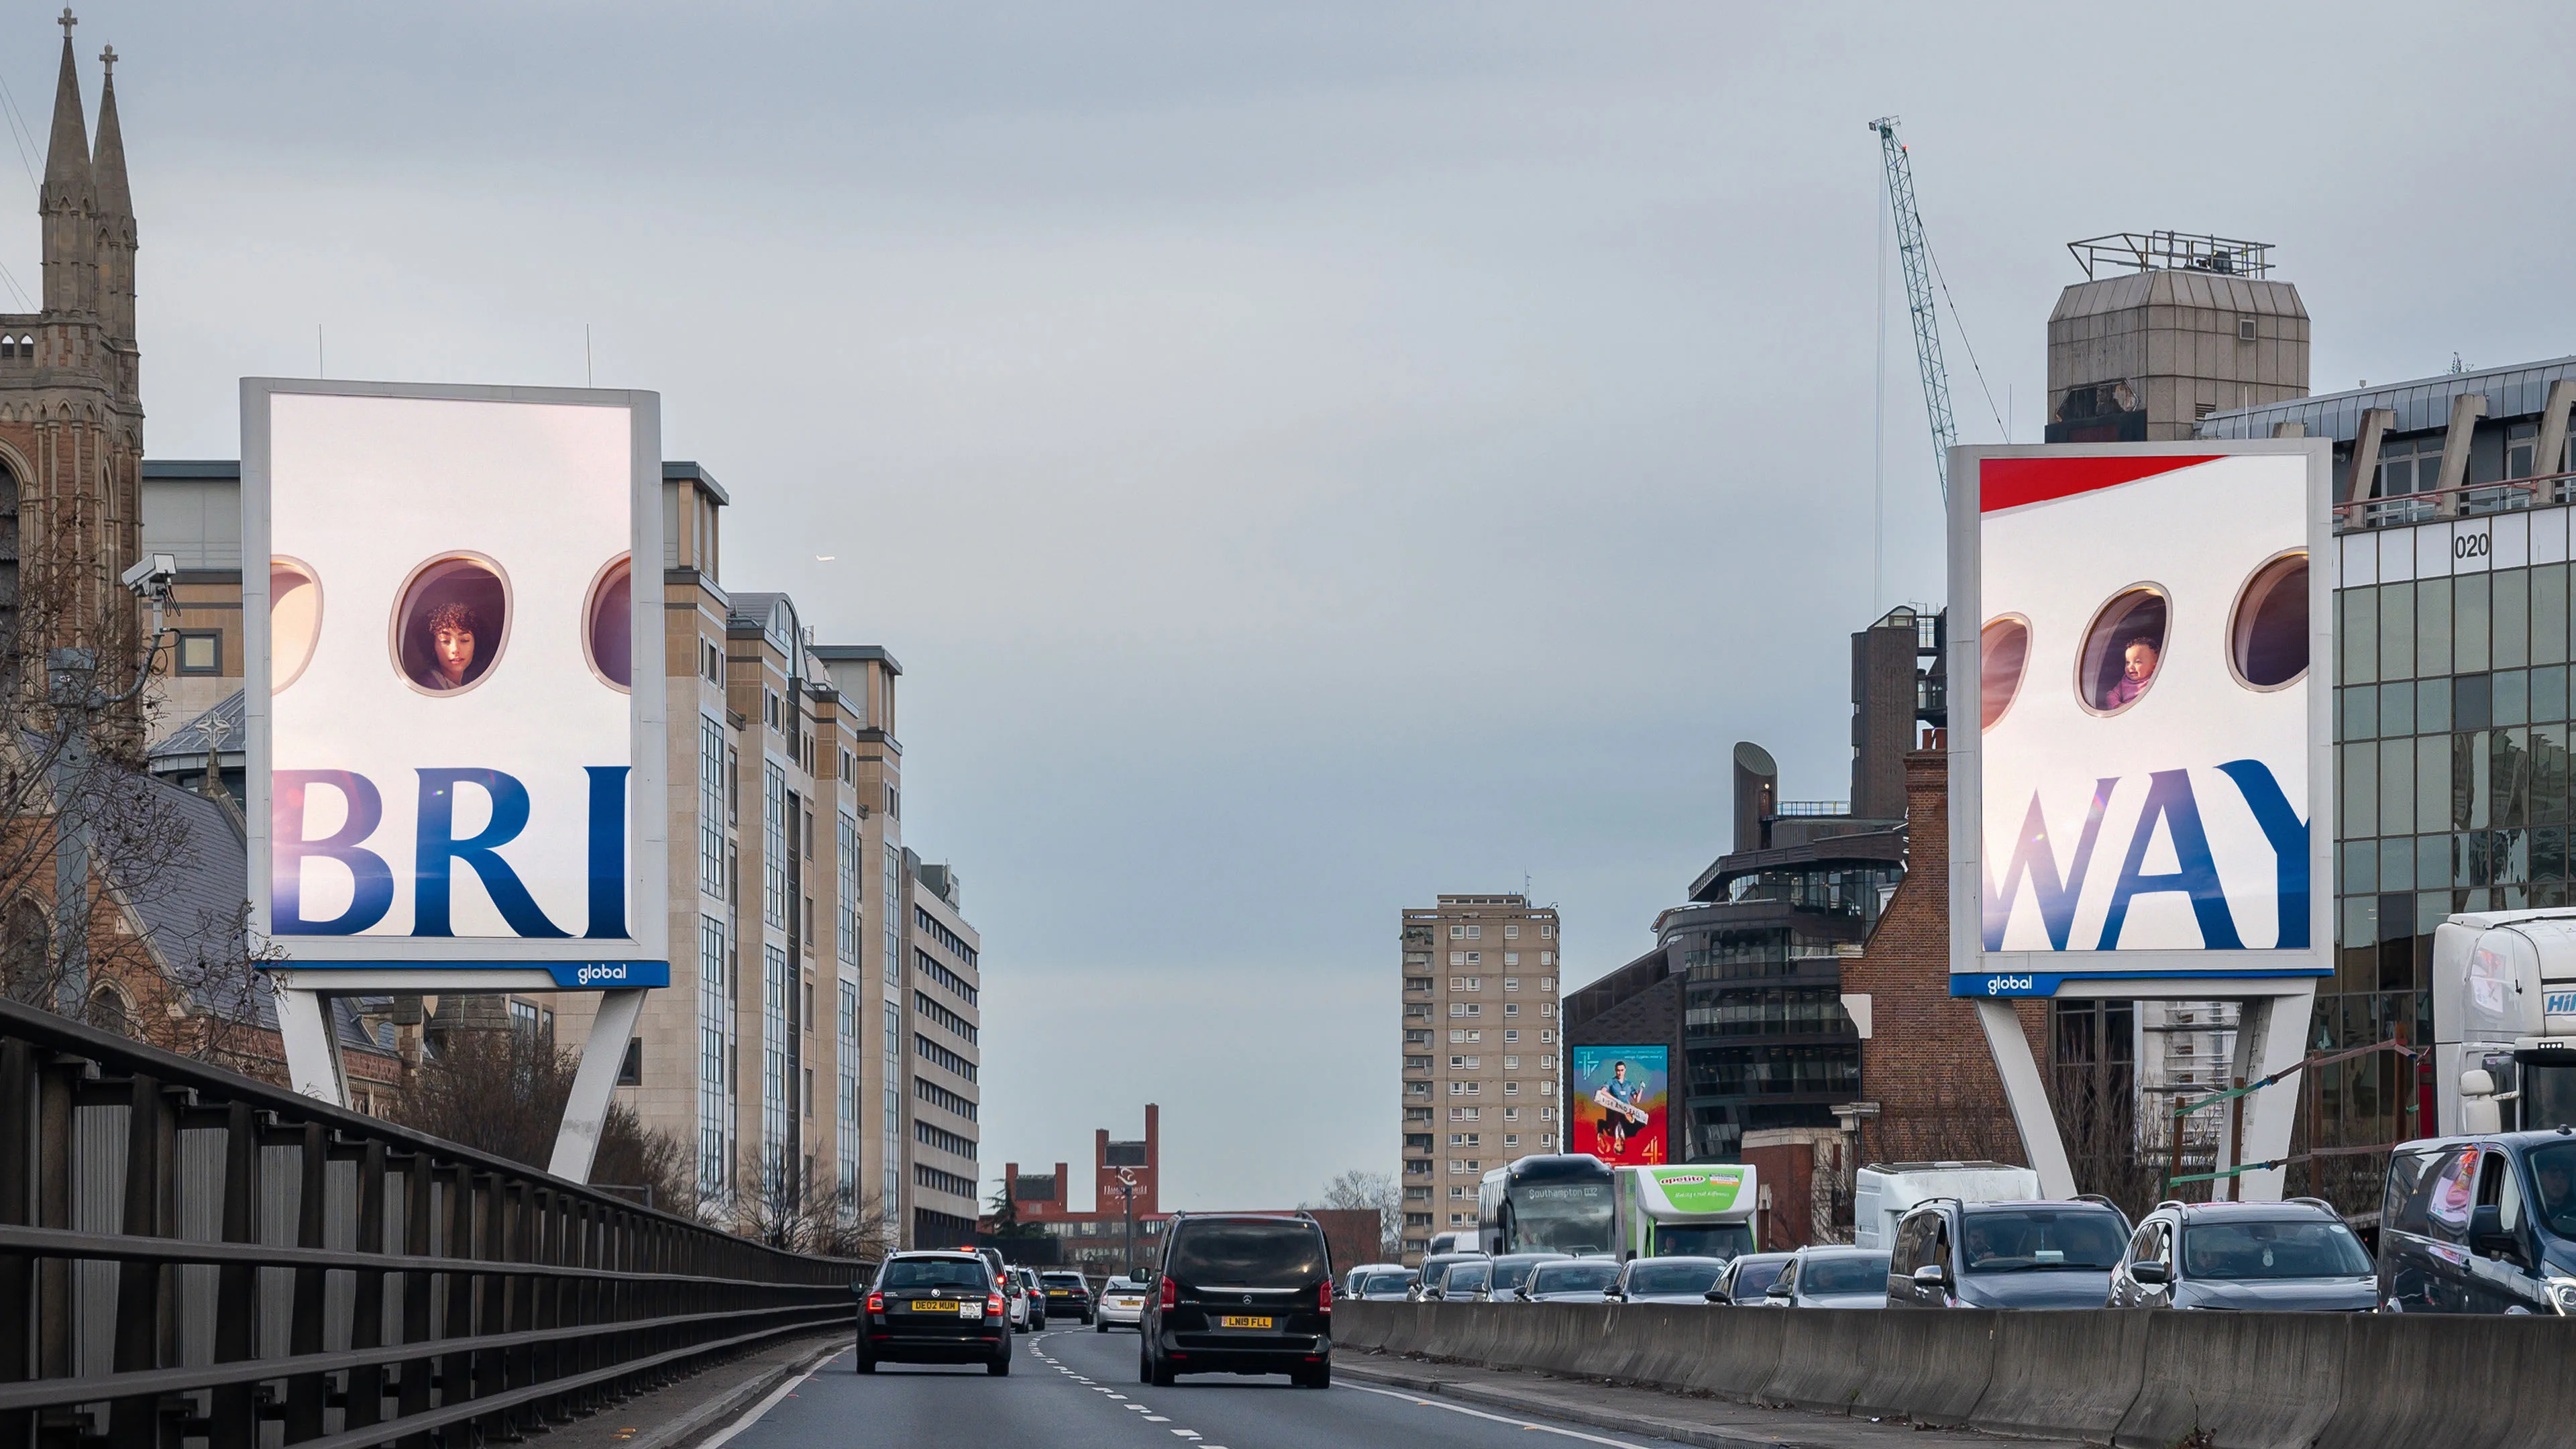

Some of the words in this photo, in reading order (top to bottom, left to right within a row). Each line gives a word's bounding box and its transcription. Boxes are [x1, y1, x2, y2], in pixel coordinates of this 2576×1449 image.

[2455, 533, 2489, 559] 020
[271, 765, 632, 938] BRI
[1982, 759, 2310, 951] WAY
[578, 963, 627, 985] global
[1987, 975, 2032, 996] global
[1661, 1175, 1703, 1184] apetito
[1529, 1188, 1582, 1199] Southampton
[1229, 1318, 1249, 1326] LN19
[1251, 1318, 1269, 1327] FLL
